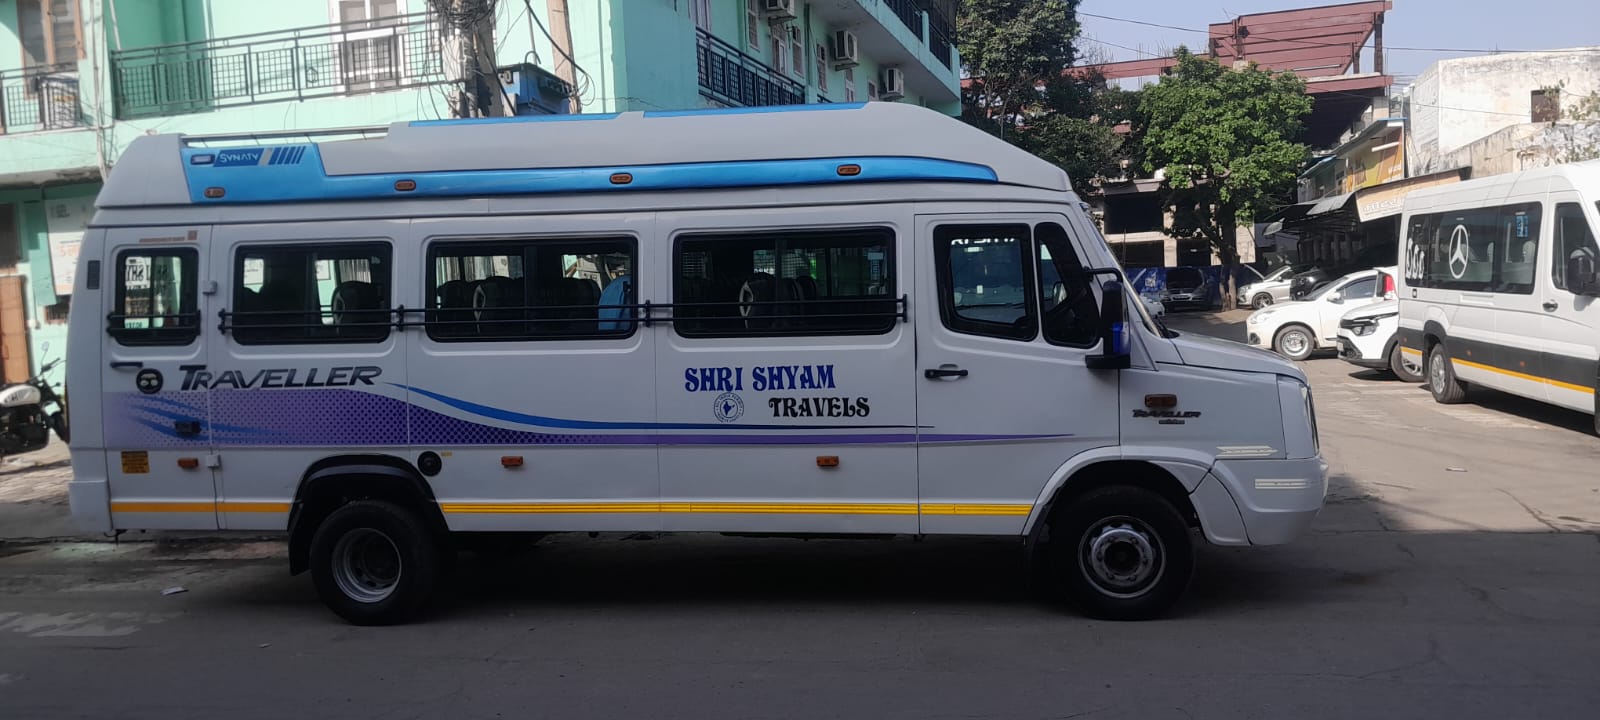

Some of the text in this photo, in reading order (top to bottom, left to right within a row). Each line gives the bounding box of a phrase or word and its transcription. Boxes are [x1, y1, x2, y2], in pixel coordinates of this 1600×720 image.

[179, 364, 383, 391] TRAVELLER
[684, 364, 836, 392] SHRI SHYAM
[768, 396, 870, 418] TRAVELS
